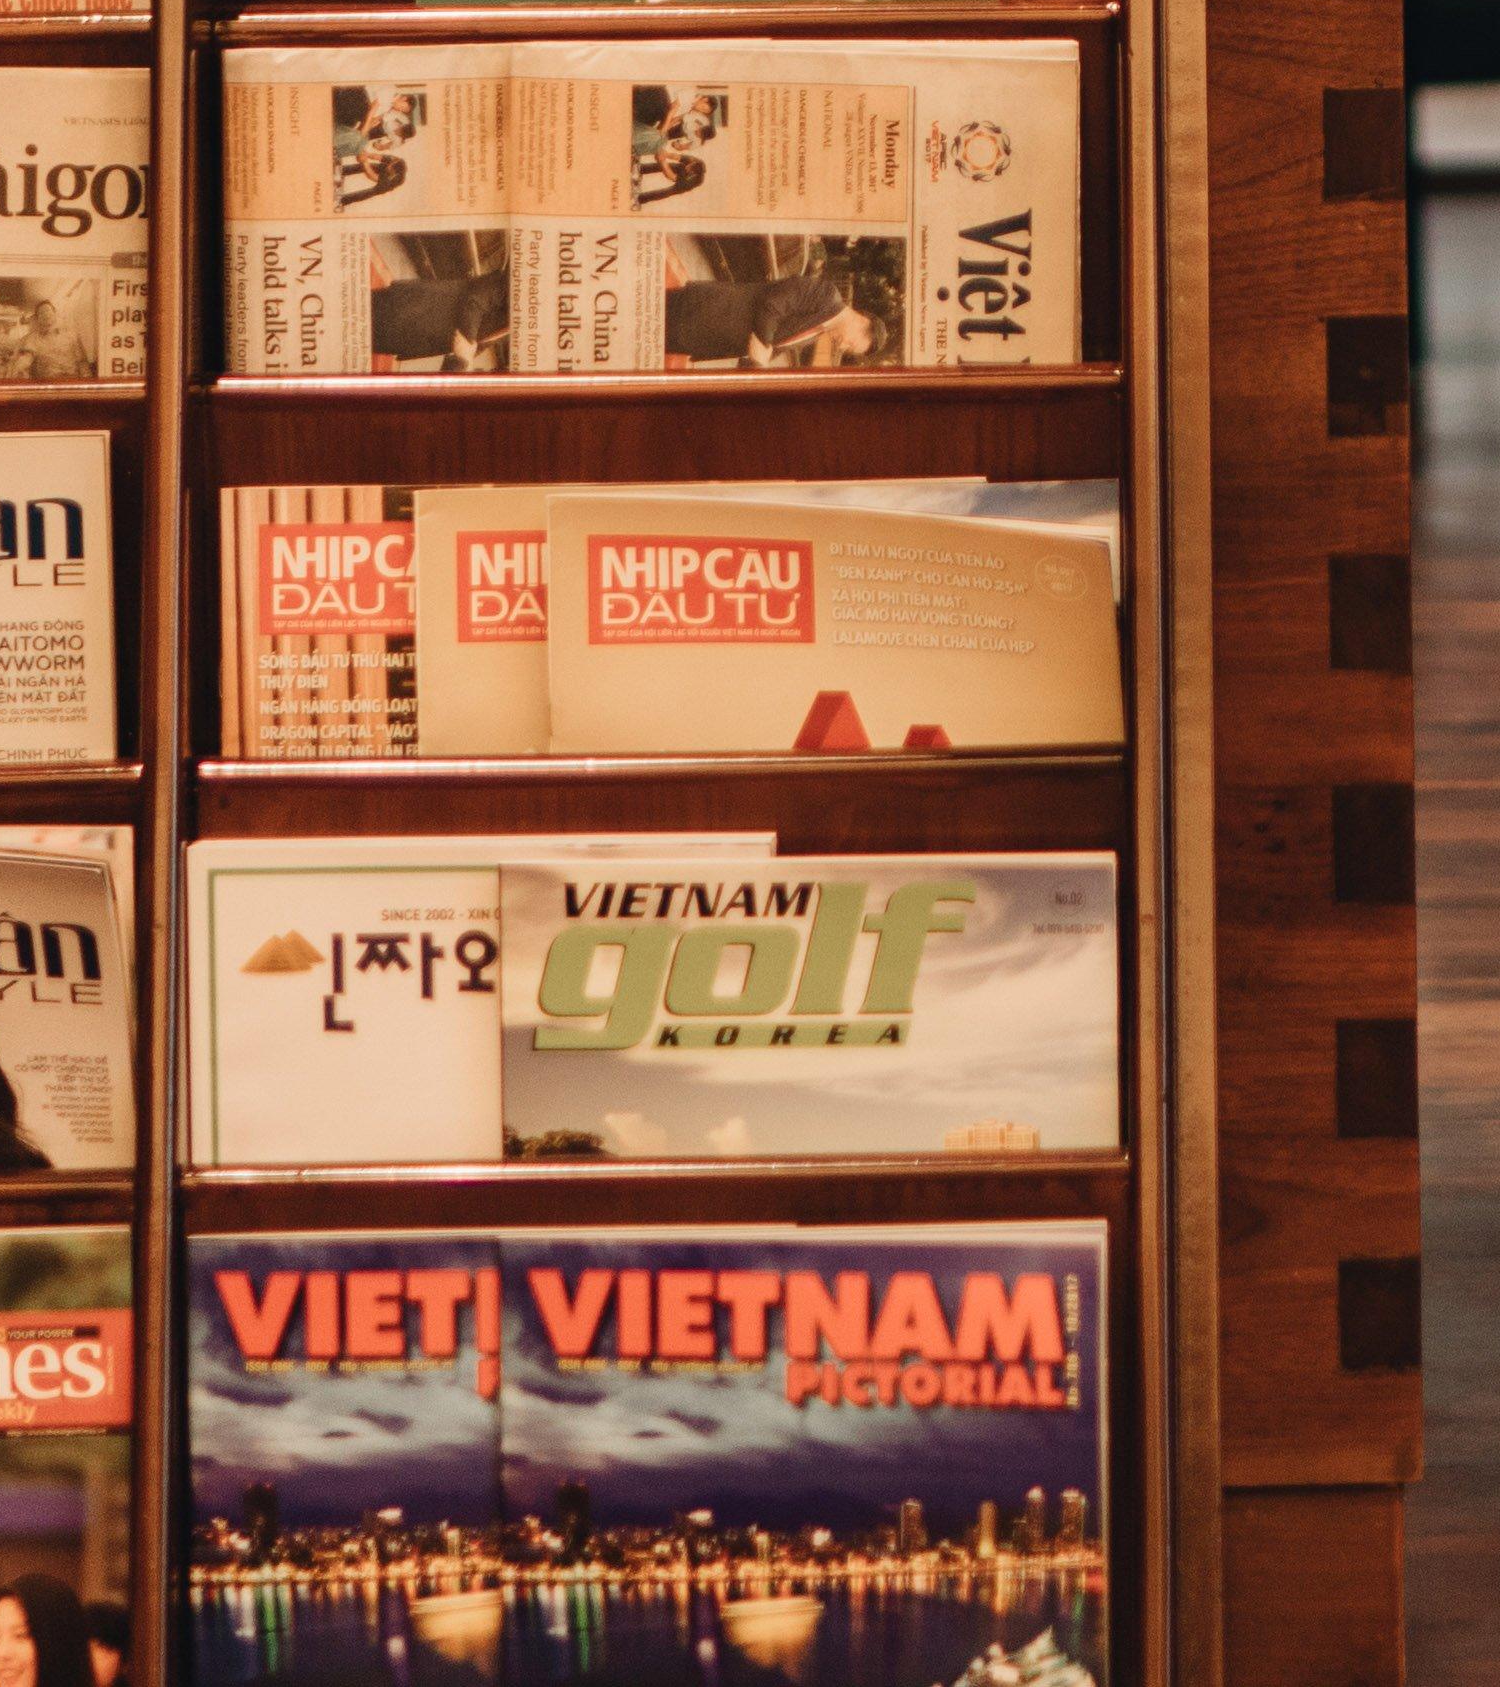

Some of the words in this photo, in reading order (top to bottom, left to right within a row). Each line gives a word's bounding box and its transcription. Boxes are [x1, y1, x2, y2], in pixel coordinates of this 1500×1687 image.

[290, 87, 299, 136] INSIGHT
[589, 83, 599, 132] INSIGHT
[822, 90, 833, 149] NATIONAL
[566, 126, 574, 170] INVASION
[868, 114, 878, 160] November
[881, 120, 901, 188] Monday
[611, 179, 620, 202] PAGE
[237, 235, 249, 275] Party
[263, 235, 287, 289] hold
[297, 234, 323, 283] VN,
[510, 228, 523, 304] highlighted
[529, 230, 543, 270] Party
[558, 231, 583, 286] hold
[590, 233, 620, 280] VN,
[937, 208, 1032, 341] Việt
[237, 278, 248, 336] leaders
[528, 273, 542, 330] leaders
[557, 294, 583, 350] talks
[111, 333, 134, 348] as
[264, 299, 288, 355] talks
[300, 293, 324, 366] China
[512, 306, 523, 345] their
[594, 290, 618, 363] China
[936, 319, 948, 350] THE
[238, 339, 248, 374] from
[527, 332, 542, 367] from
[0, 621, 39, 631] HANG
[260, 725, 318, 740] DRAGON
[320, 723, 372, 739] CAPITAL
[382, 909, 420, 921] SINCE
[425, 909, 455, 921] 2002
[468, 909, 490, 920] XIN
[563, 882, 816, 919] VIETNAM
[532, 880, 977, 1051] golf
[656, 1024, 902, 1048] KOREA
[8, 1330, 37, 1340] YOUR
[527, 1268, 1065, 1362] VIETNAM
[785, 1363, 1066, 1410] PICTORIAL
